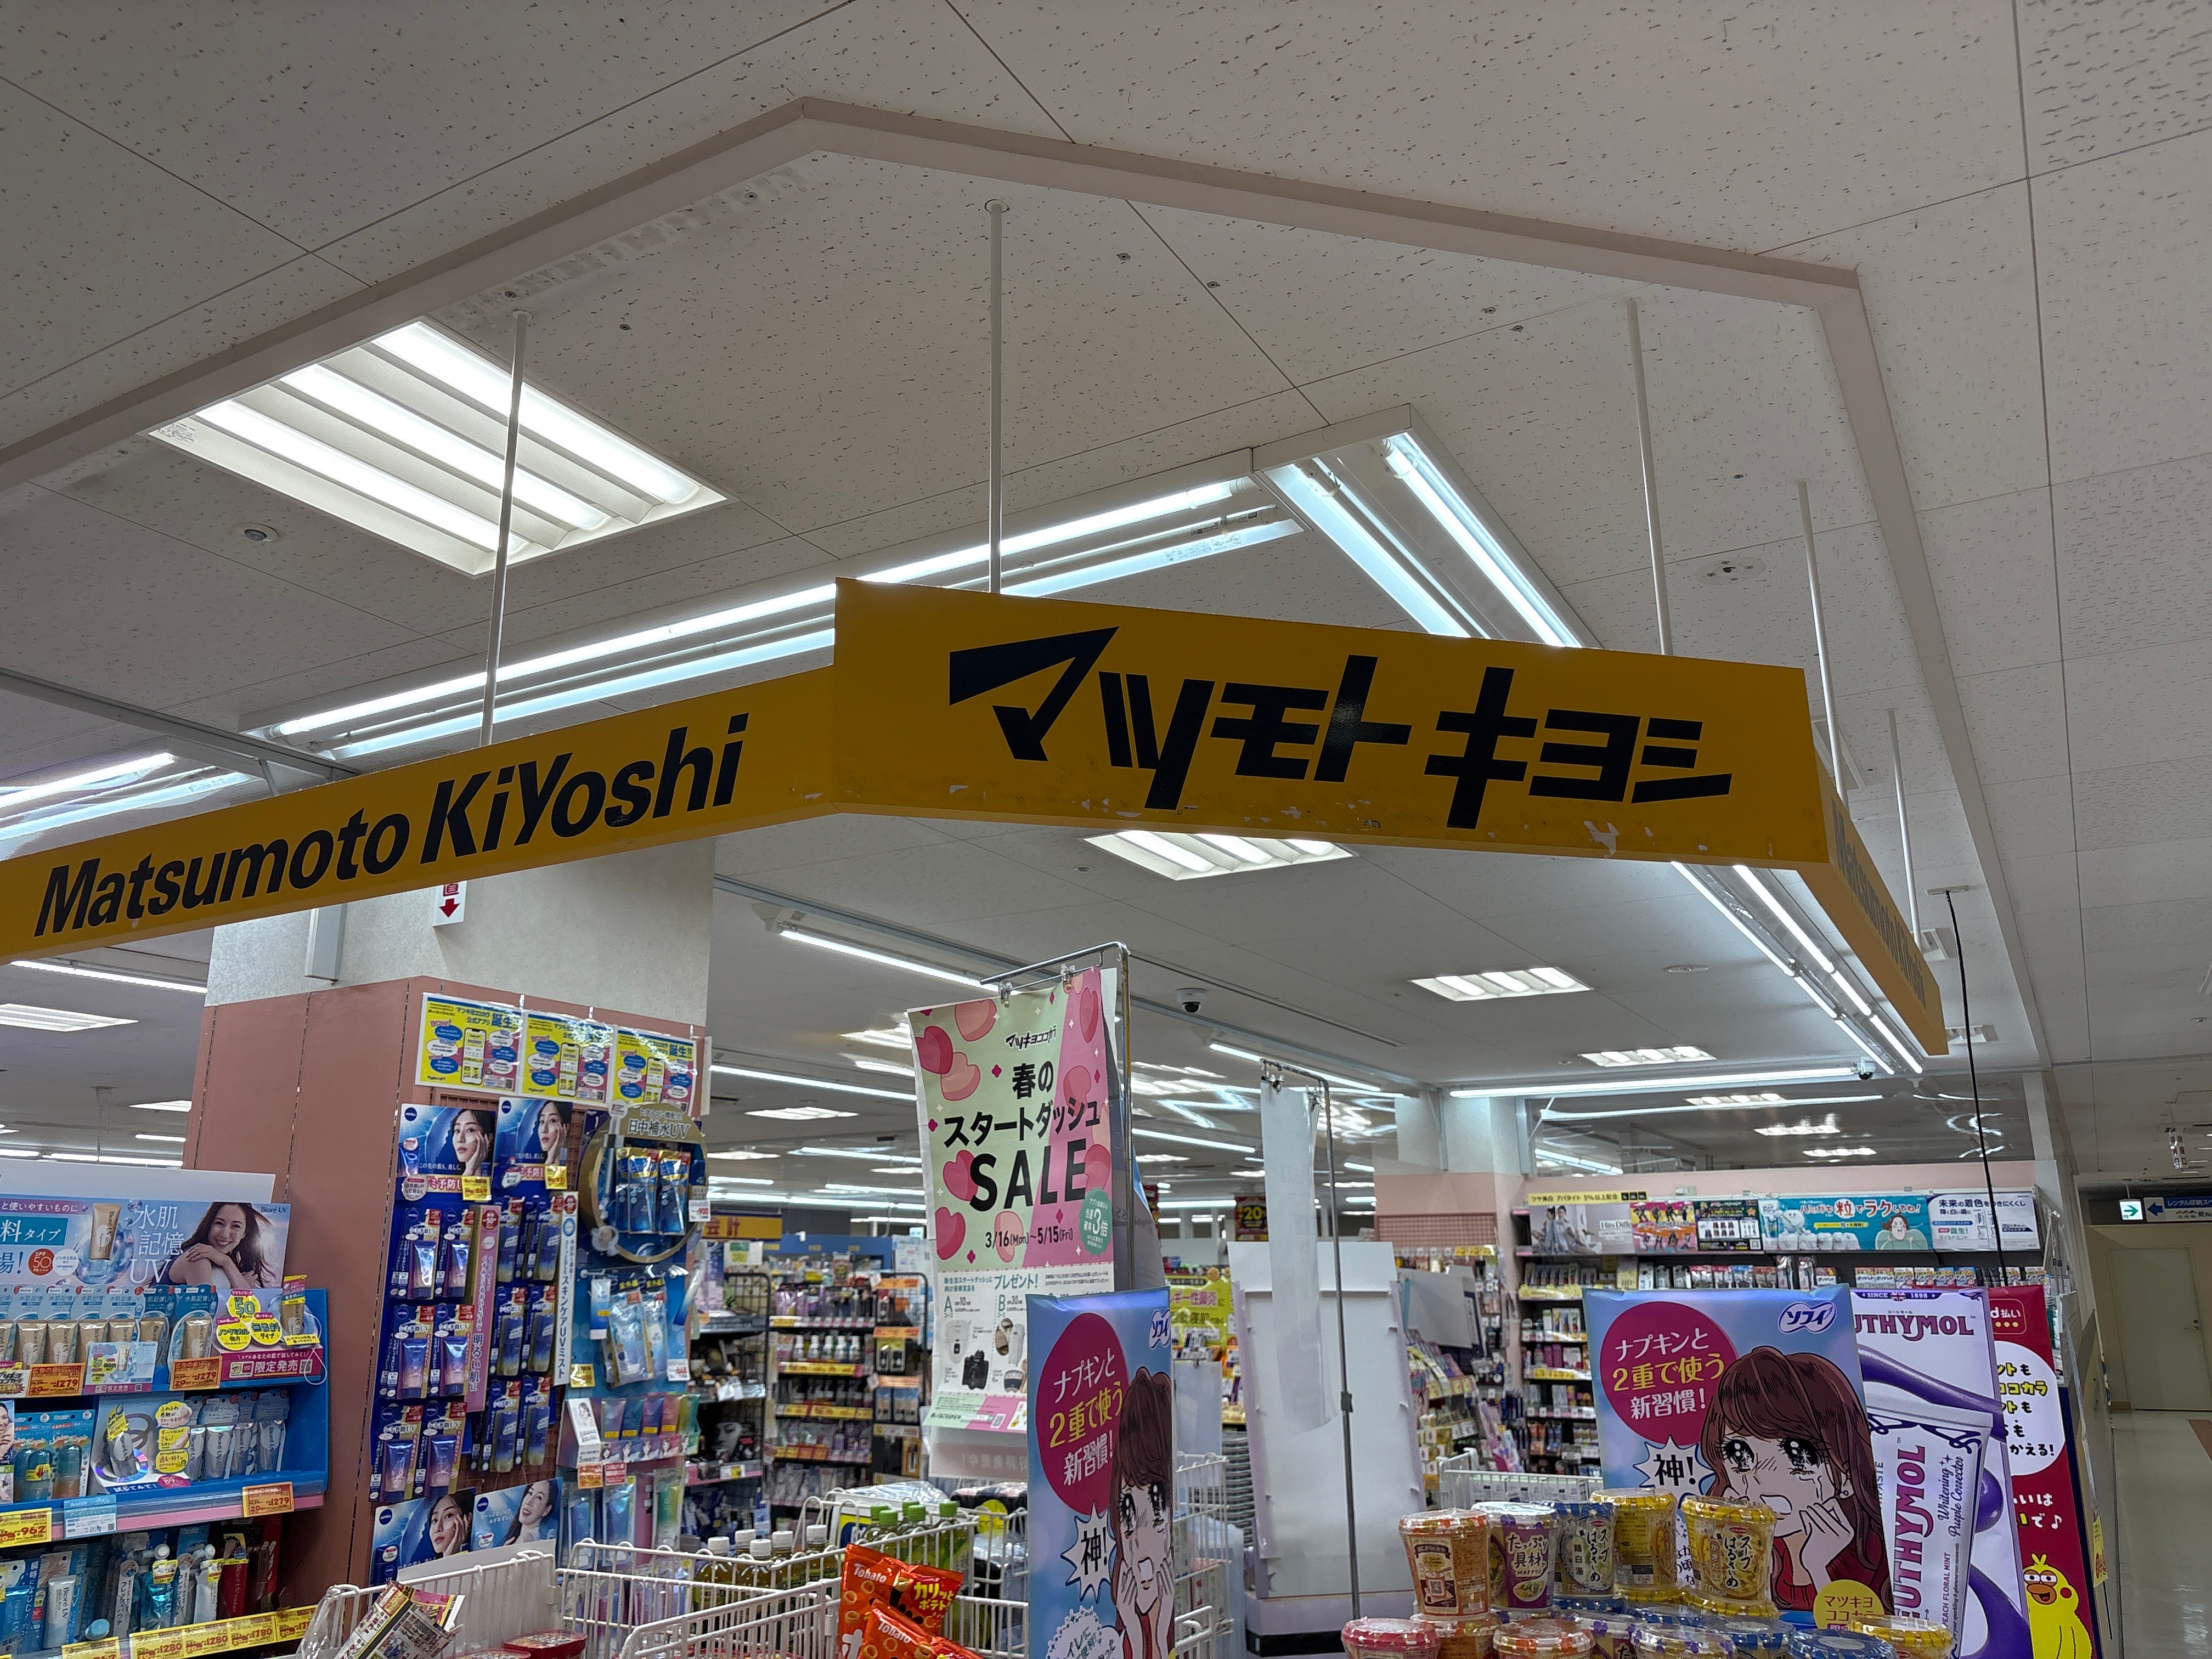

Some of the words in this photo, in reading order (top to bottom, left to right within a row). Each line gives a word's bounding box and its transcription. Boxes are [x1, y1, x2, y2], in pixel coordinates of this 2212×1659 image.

[949, 627, 1732, 829] マツモトキヨシ
[34, 808, 410, 937] Matsumoto
[420, 712, 751, 865] KiYoshi
[1012, 1061, 1054, 1099] 春の
[628, 1119, 690, 1139] 日中補水UV
[944, 1097, 1100, 1148] スタートダッシュ
[969, 1138, 1086, 1211] SALE
[131, 1204, 178, 1229] 水肌
[706, 1216, 746, 1237] 会計
[138, 1231, 185, 1256] 記憶
[33, 1256, 52, 1268] 50
[129, 1259, 172, 1284] UV
[994, 1273, 1039, 1290] プレゼント!
[235, 1301, 256, 1315] 50
[944, 1296, 953, 1312] A
[998, 1294, 1006, 1312] B
[1990, 1307, 2022, 1318] d払い
[557, 1276, 570, 1379] スキンケアUVミスト
[1615, 1327, 1710, 1362] ナプキンと
[197, 1372, 217, 1380] 1279
[255, 1359, 298, 1374] 限定発売
[1053, 1347, 1116, 1403] ナプキンと
[1612, 1353, 1726, 1392] 2重で使う
[57, 1379, 78, 1387] 1279
[1048, 1380, 1124, 1448] 2重で使う
[1630, 1387, 1706, 1420] 新習慣!
[1063, 1430, 1114, 1486] 新習慣!
[2009, 1442, 2055, 1457] かえる!
[1653, 1454, 1696, 1486] 神!
[1950, 1455, 1964, 1502] Corrector
[270, 1497, 289, 1506] 1279
[1937, 1467, 1954, 1521] Whitening
[21, 1526, 46, 1534] 962
[1948, 1503, 1965, 1537] Purple
[1080, 1526, 1108, 1576] 神!
[1506, 1533, 1549, 1553] たっぷり
[1600, 1528, 1610, 1563] スープ
[1740, 1536, 1753, 1570] スープ
[1587, 1531, 1601, 1583] はるさめ
[1724, 1537, 1739, 1588] はるさめ
[854, 1562, 887, 1583] Tohato
[913, 1581, 956, 1602] カリっと
[1943, 1572, 1951, 1604] FLORAL
[1824, 1596, 1873, 1609] マツキヨ
[207, 1635, 228, 1645] 1280
[252, 1628, 273, 1639] 1780
[877, 1621, 912, 1644] Tohato
